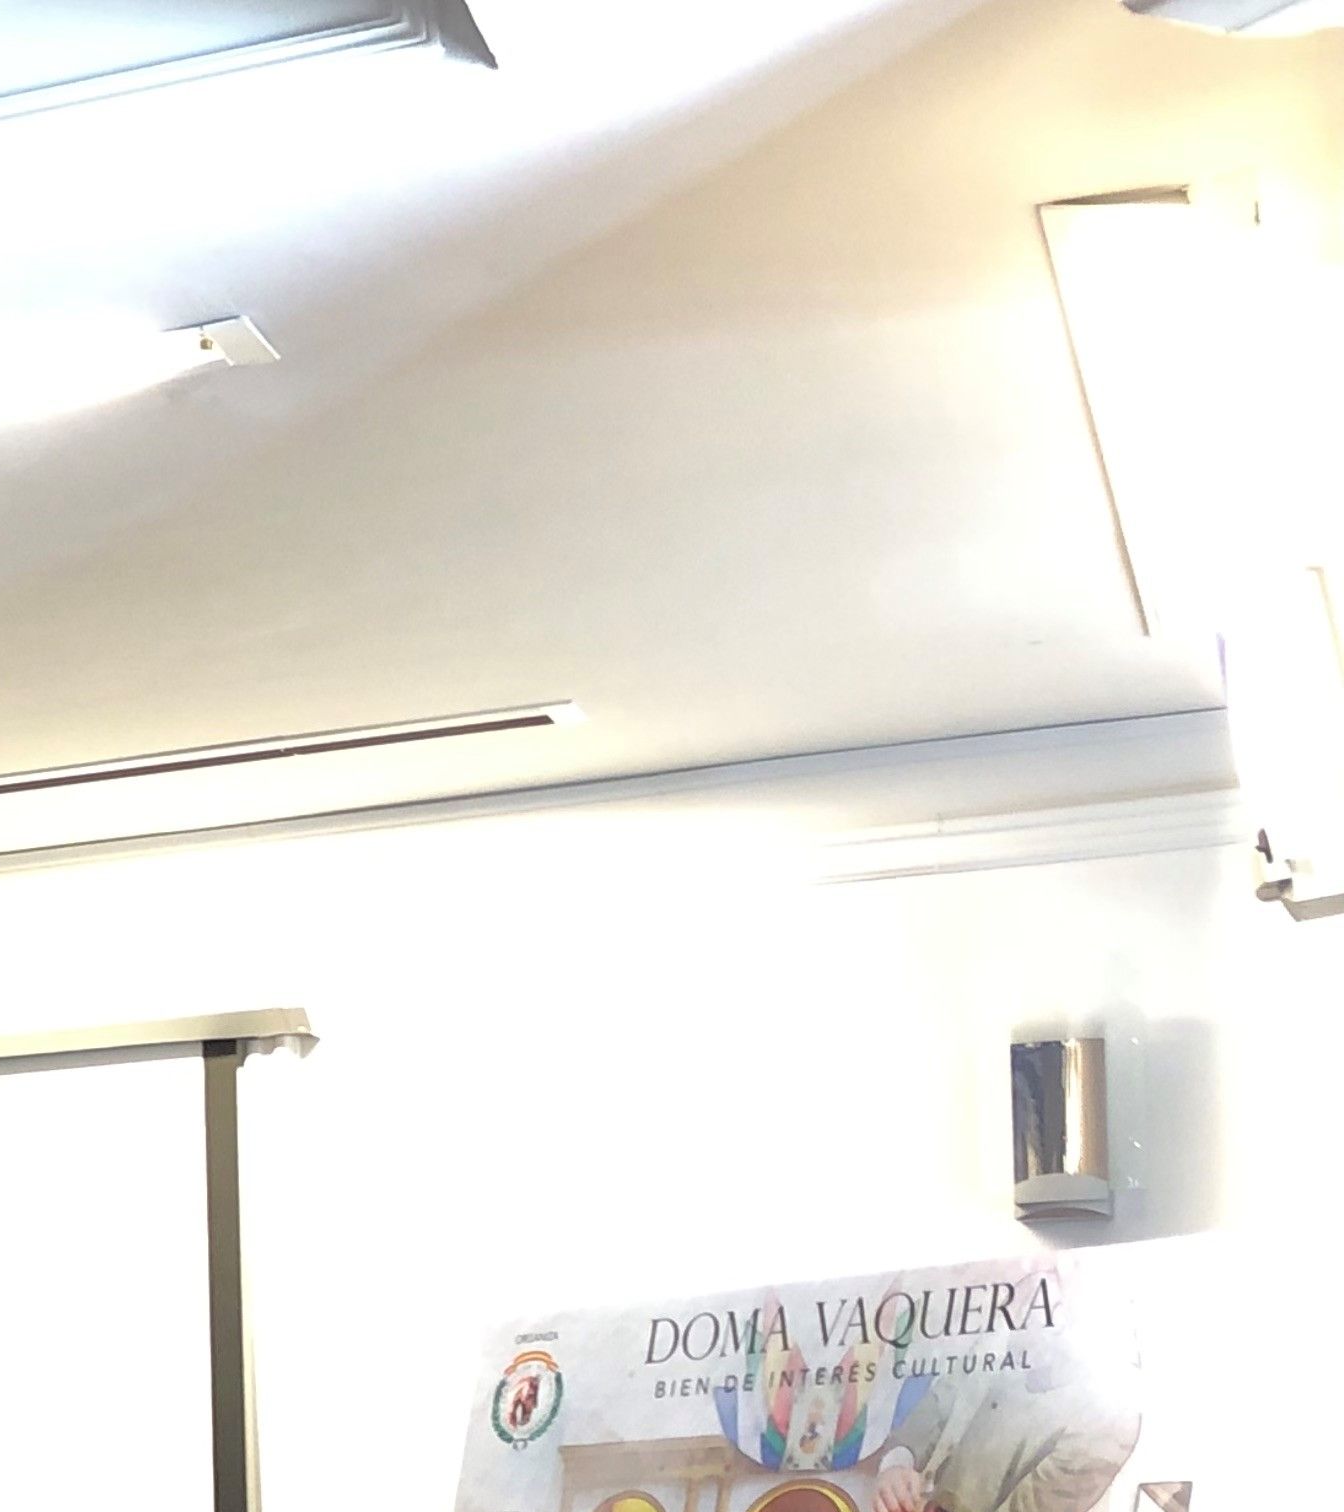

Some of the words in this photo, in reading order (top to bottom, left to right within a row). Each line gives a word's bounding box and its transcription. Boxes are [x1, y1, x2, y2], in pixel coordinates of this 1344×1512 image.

[645, 1305, 790, 1364] DOMA
[817, 1278, 1055, 1348] VAQUERA
[654, 1378, 709, 1399] BIEN
[724, 1373, 753, 1393] DE
[892, 1350, 1031, 1380] CULTURAL
